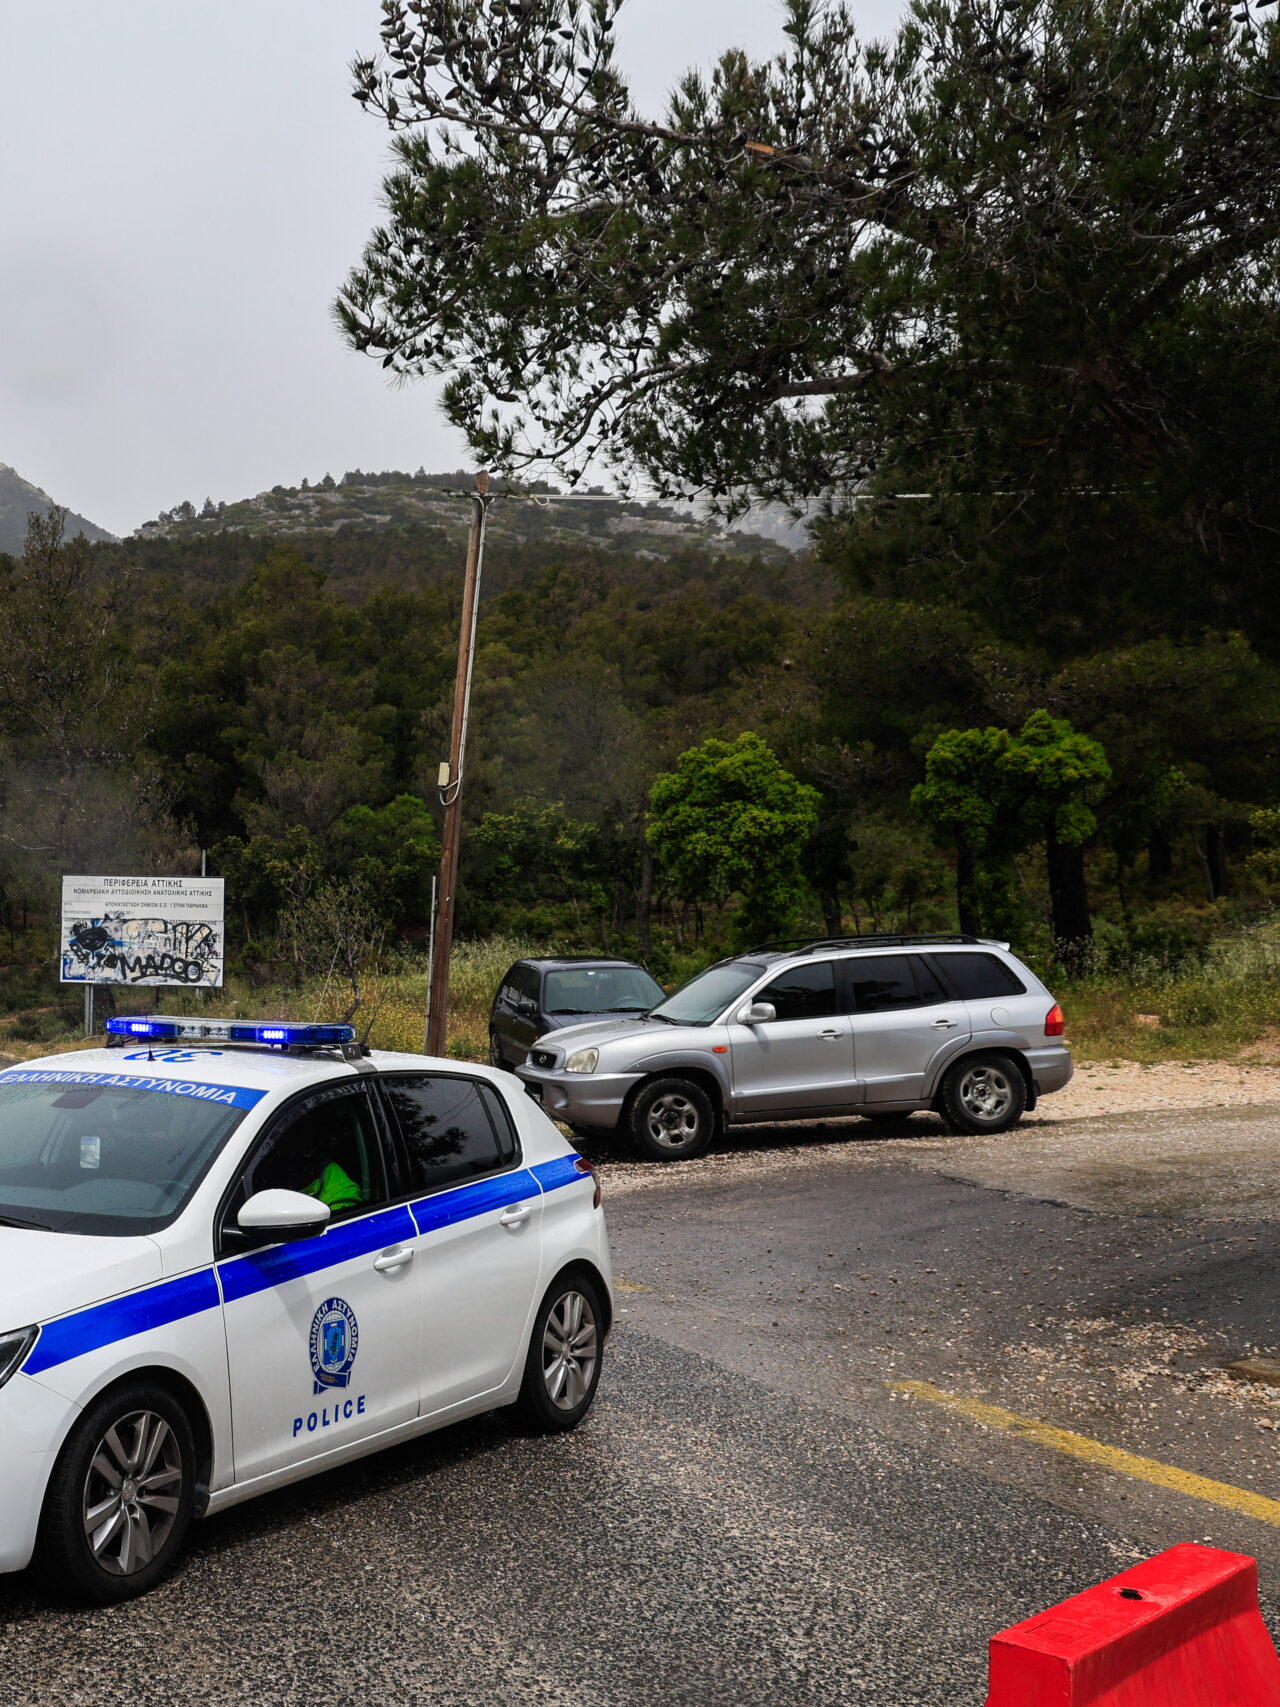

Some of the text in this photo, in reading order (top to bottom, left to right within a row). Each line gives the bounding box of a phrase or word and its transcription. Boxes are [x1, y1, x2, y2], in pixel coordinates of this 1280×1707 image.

[103, 878, 183, 888] ΠΕΡΙΦΕΡΕΙΑ ΑΤΤΙΚΗΣ
[100, 1074, 237, 1104] ΑΣΤΥΝΟΜΙΑ
[310, 1299, 358, 1373] ΕΛΛΗΝΙΚΗ ΑΣΤΥΝΟΜΙΑ
[292, 1394, 366, 1438] POLICE
